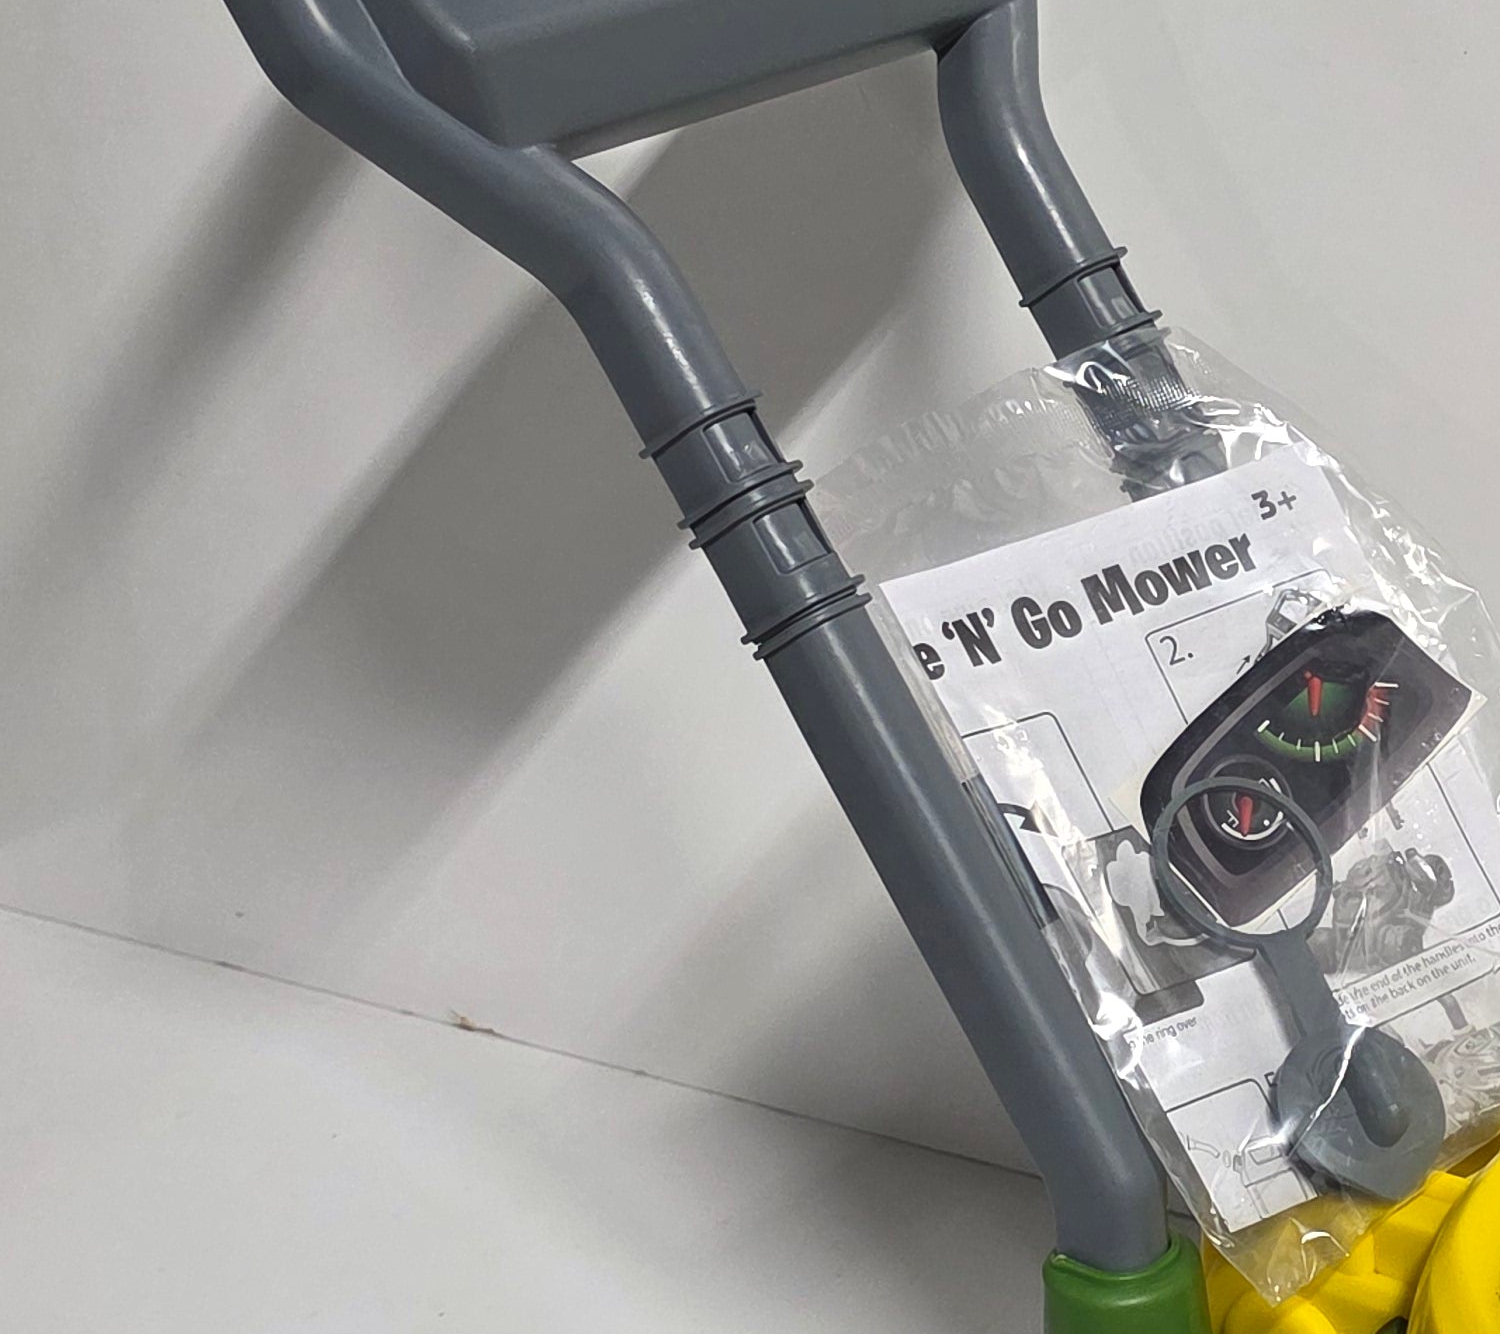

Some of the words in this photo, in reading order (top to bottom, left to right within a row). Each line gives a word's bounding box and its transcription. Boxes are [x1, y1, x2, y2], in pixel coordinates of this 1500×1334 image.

[1251, 490, 1297, 520] 3+
[1011, 596, 1082, 649] Go
[1080, 532, 1257, 625] Mower
[1160, 636, 1194, 666] 2.
[1369, 974, 1391, 992] end
[1402, 961, 1422, 977] the
[1421, 942, 1465, 967] handles
[1370, 993, 1389, 1008] the
[1388, 979, 1417, 999] back
[1416, 974, 1432, 987] on
[1430, 965, 1450, 979] the
[1156, 1026, 1178, 1041] ring
[1177, 1017, 1198, 1031] over
